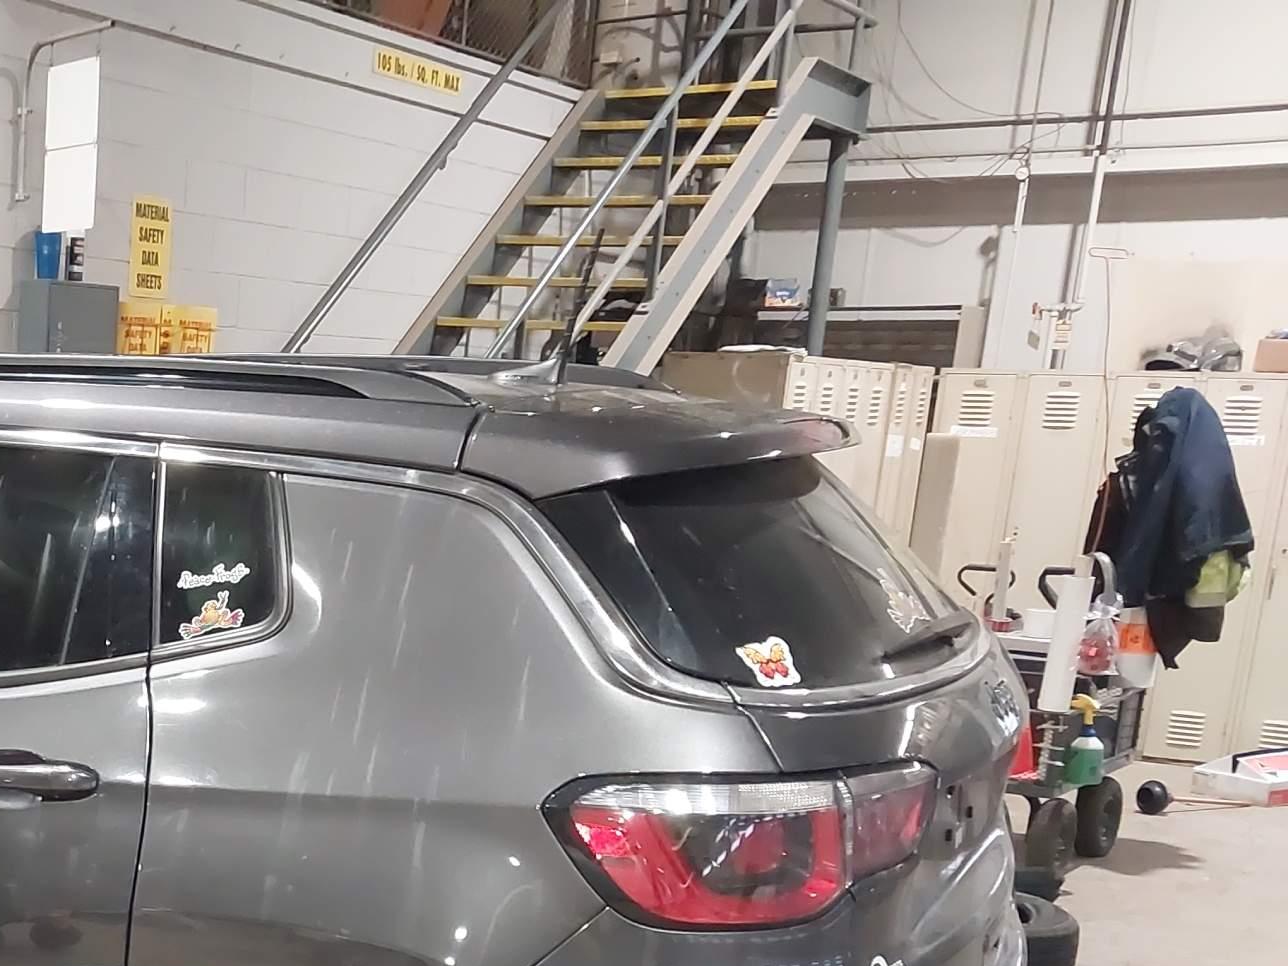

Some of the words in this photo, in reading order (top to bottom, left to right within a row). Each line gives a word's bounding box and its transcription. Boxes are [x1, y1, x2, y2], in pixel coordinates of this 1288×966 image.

[377, 52, 392, 72] 105
[394, 57, 408, 77] lbs.
[416, 64, 428, 83] SQ.
[431, 69, 441, 87] FT.
[444, 73, 460, 92] MAX
[135, 202, 170, 223] MATERIAL
[138, 226, 165, 244] SAFETY
[141, 250, 160, 266] DATA
[136, 272, 162, 290] SHEETS
